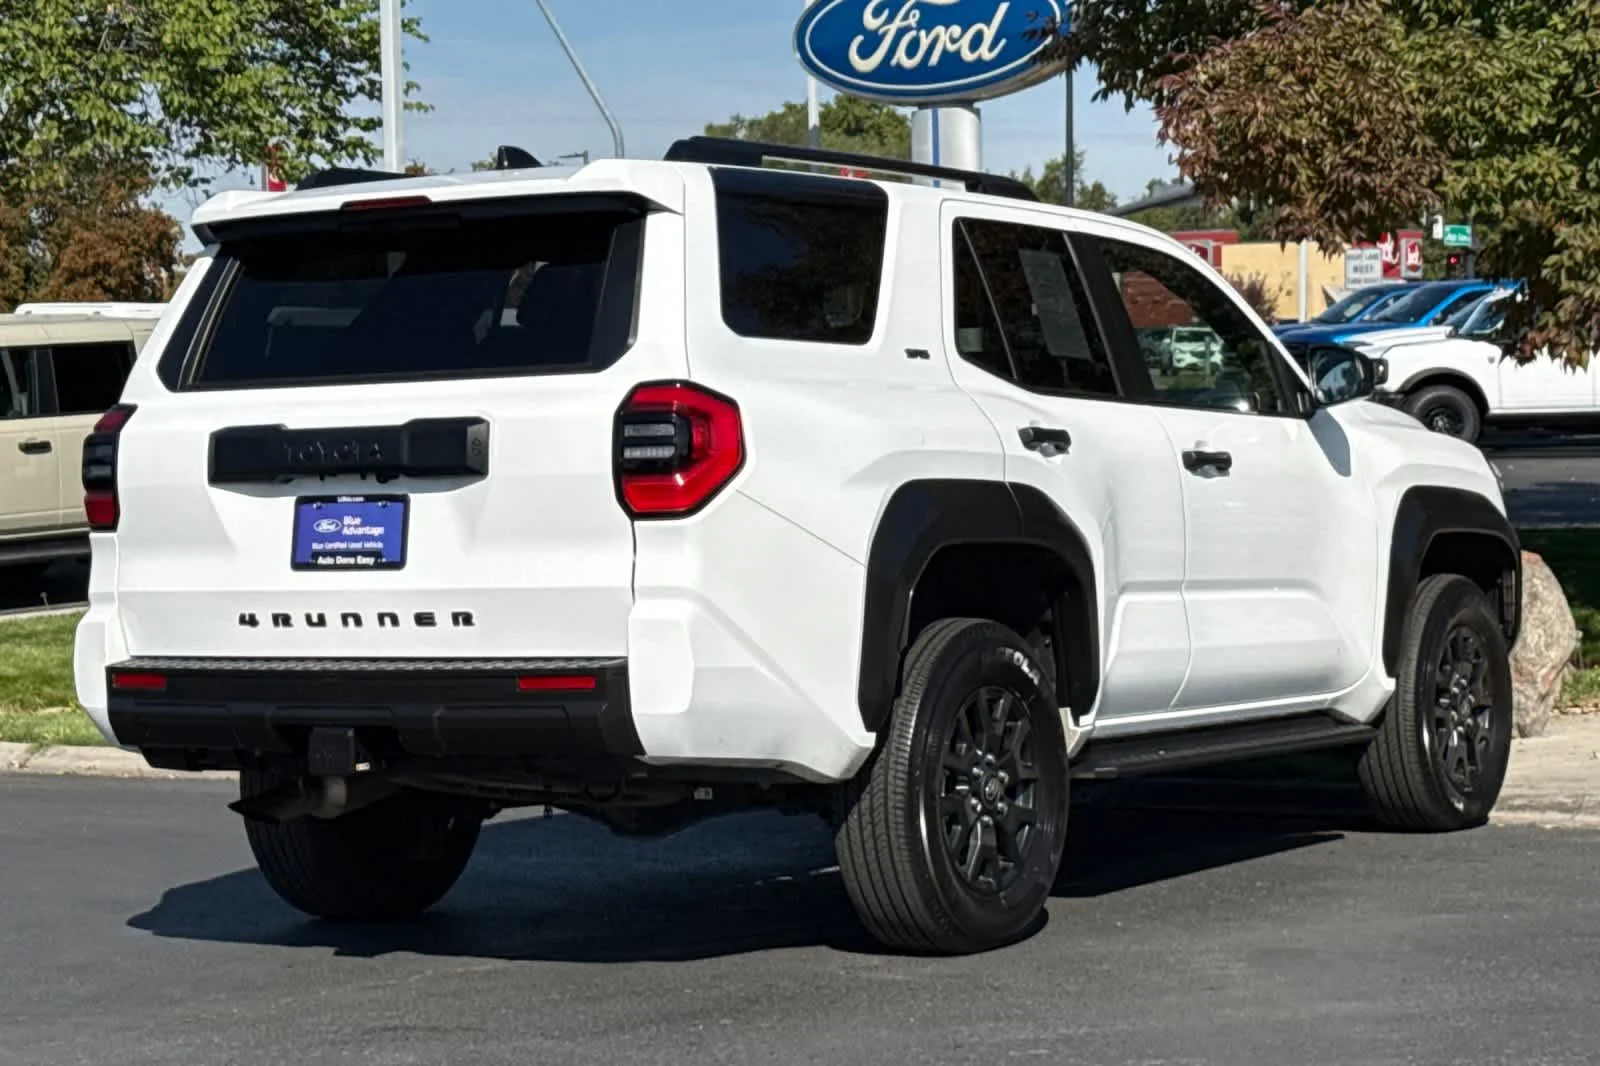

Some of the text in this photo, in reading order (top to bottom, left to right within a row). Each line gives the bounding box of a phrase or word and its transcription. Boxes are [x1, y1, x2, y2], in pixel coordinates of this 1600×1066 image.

[849, 0, 1010, 73] Ford
[281, 439, 385, 465] TOYOTA
[343, 515, 362, 525] Blue
[342, 526, 385, 536] Advantage
[317, 556, 335, 566] Auto
[238, 611, 476, 628] 4RUNNER
